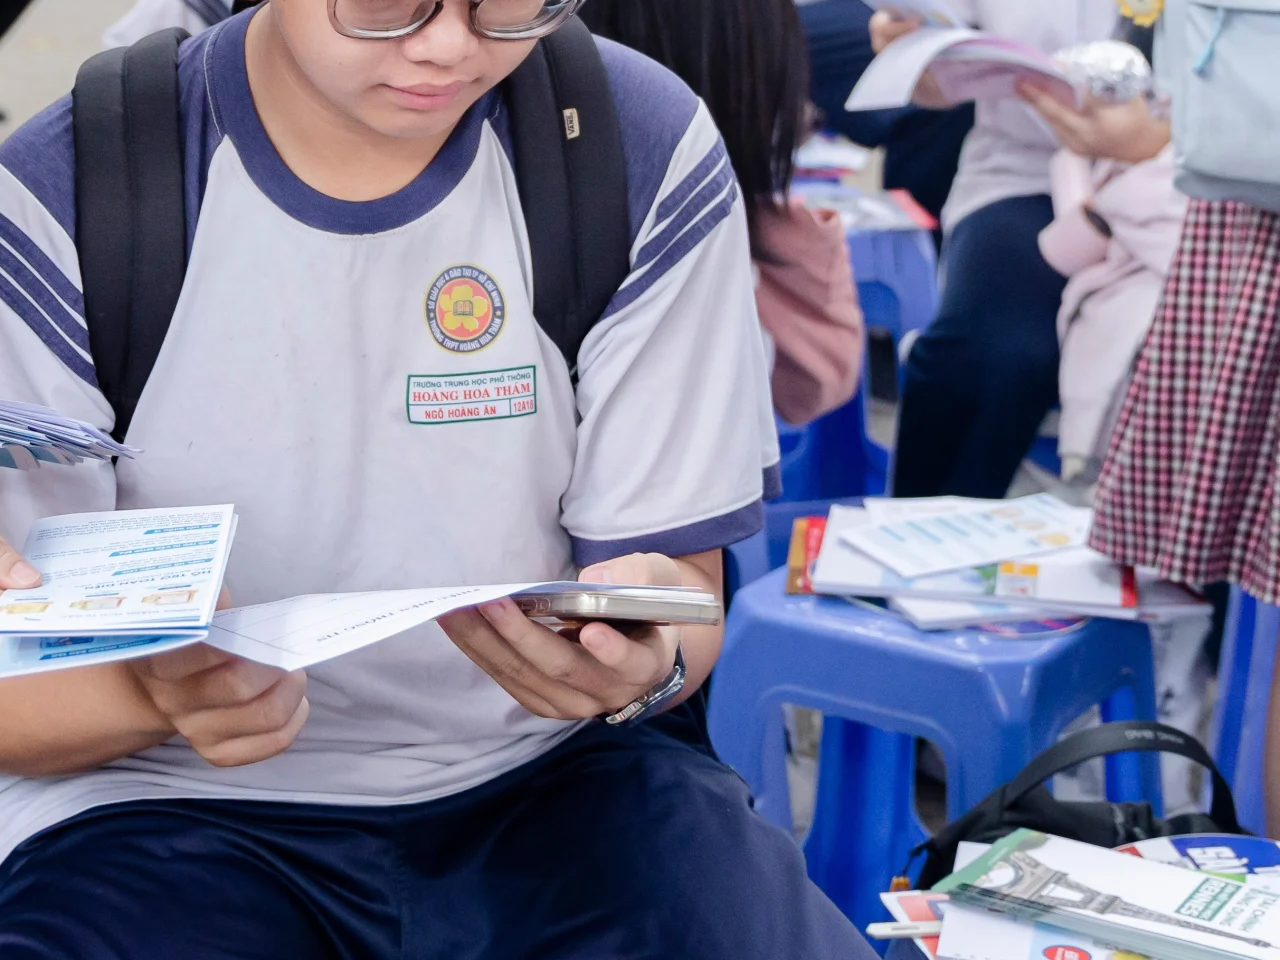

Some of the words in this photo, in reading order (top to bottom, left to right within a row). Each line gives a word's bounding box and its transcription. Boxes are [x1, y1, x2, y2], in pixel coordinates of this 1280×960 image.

[442, 337, 460, 351] THPT
[459, 339, 480, 351] HOÀNG
[478, 332, 493, 346] HOA
[444, 379, 469, 388] TRUNG
[471, 378, 487, 386] HỌC
[507, 372, 531, 382] THÔNG
[412, 389, 459, 402] HOÀNG
[463, 388, 490, 400] HOA
[494, 381, 531, 397] THÁM
[448, 404, 480, 419] HOÀNG
[513, 400, 534, 413] 12A18
